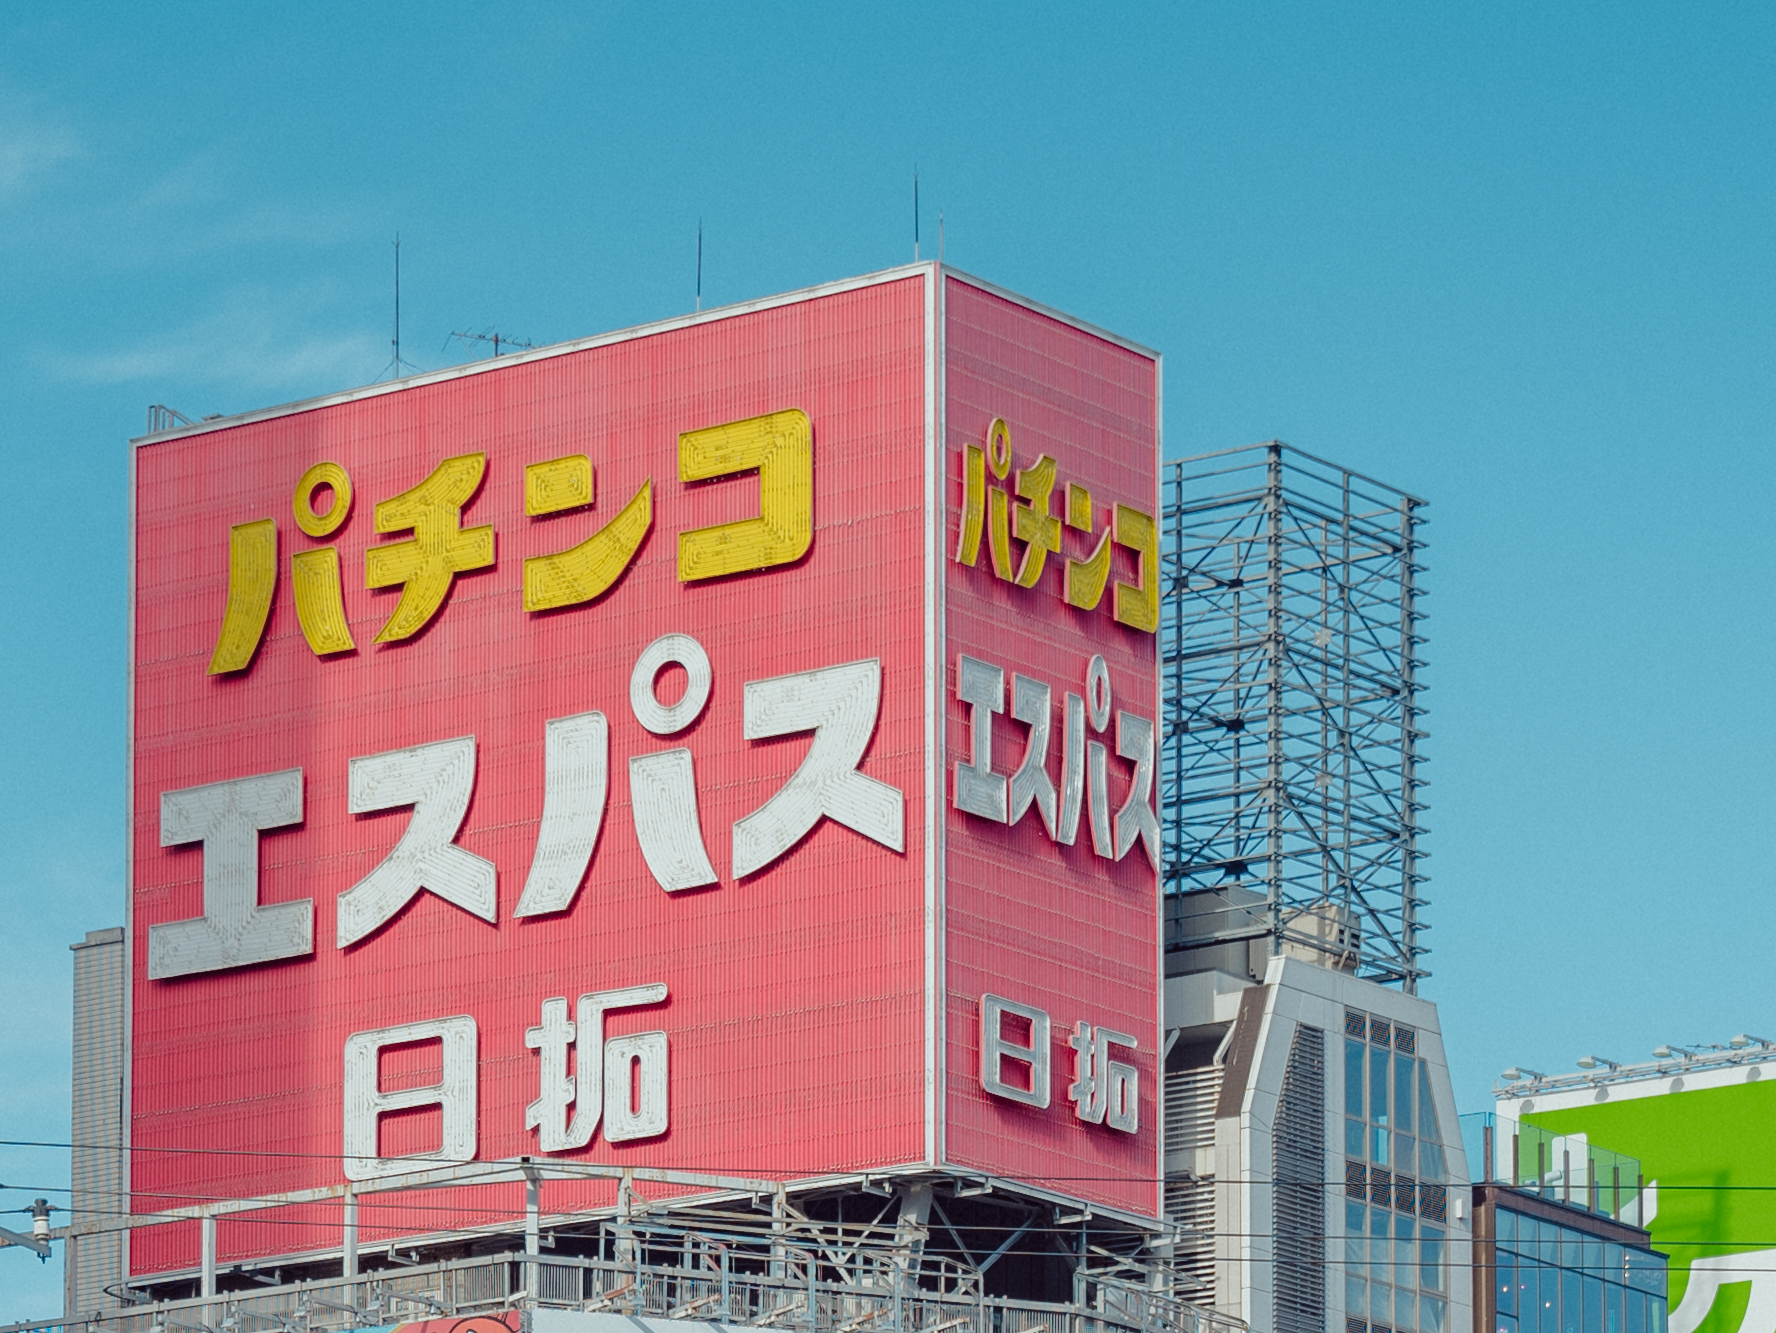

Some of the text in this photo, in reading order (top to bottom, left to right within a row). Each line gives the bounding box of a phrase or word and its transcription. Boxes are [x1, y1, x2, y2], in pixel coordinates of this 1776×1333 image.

[208, 408, 815, 676] パチンコ
[957, 418, 1160, 633] パチンコ
[148, 633, 906, 980] エスパス
[953, 654, 1160, 875] エスパス
[343, 982, 670, 1181] 日拓
[978, 993, 1139, 1135] 日拓
